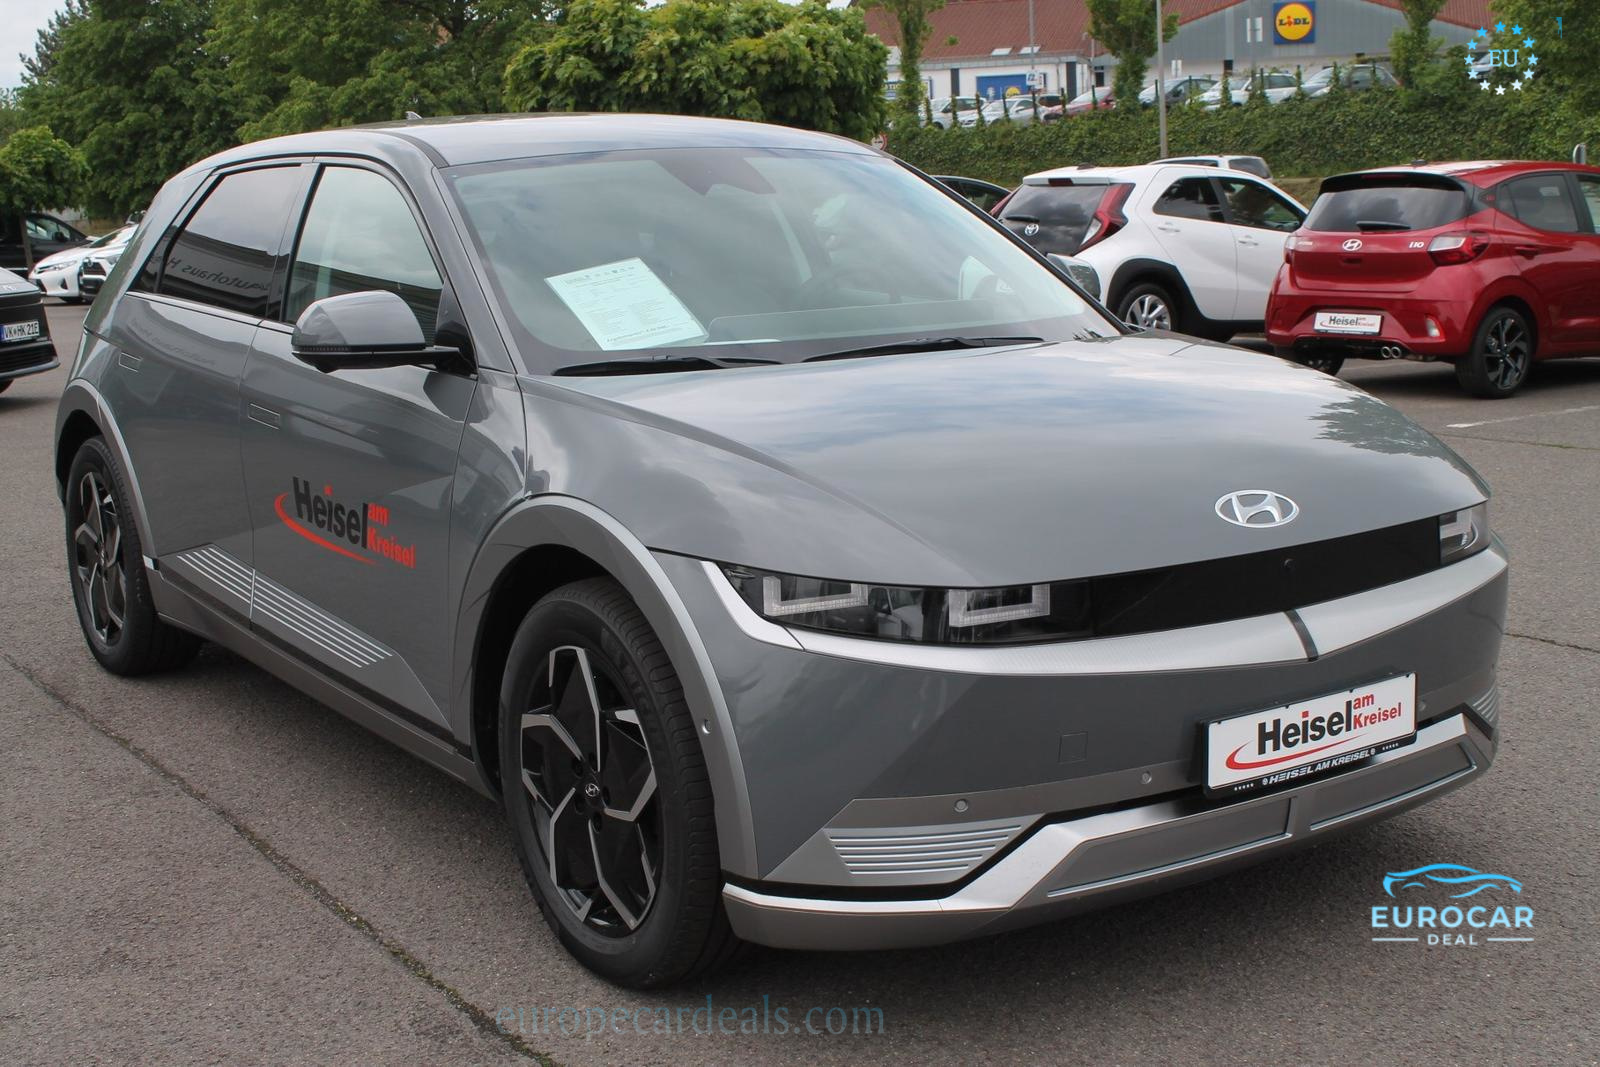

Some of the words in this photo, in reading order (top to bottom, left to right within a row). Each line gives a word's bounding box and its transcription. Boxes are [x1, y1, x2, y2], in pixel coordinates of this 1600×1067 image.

[292, 476, 369, 549] Heisel
[368, 502, 390, 527] am
[368, 527, 416, 569] Kreisel
[1353, 693, 1375, 711] am
[1353, 702, 1402, 730] Kreisel
[1258, 700, 1352, 756] Heisel
[1269, 767, 1314, 785] HEISEL
[1314, 760, 1331, 772] AM
[1331, 750, 1371, 768] KREISEL
